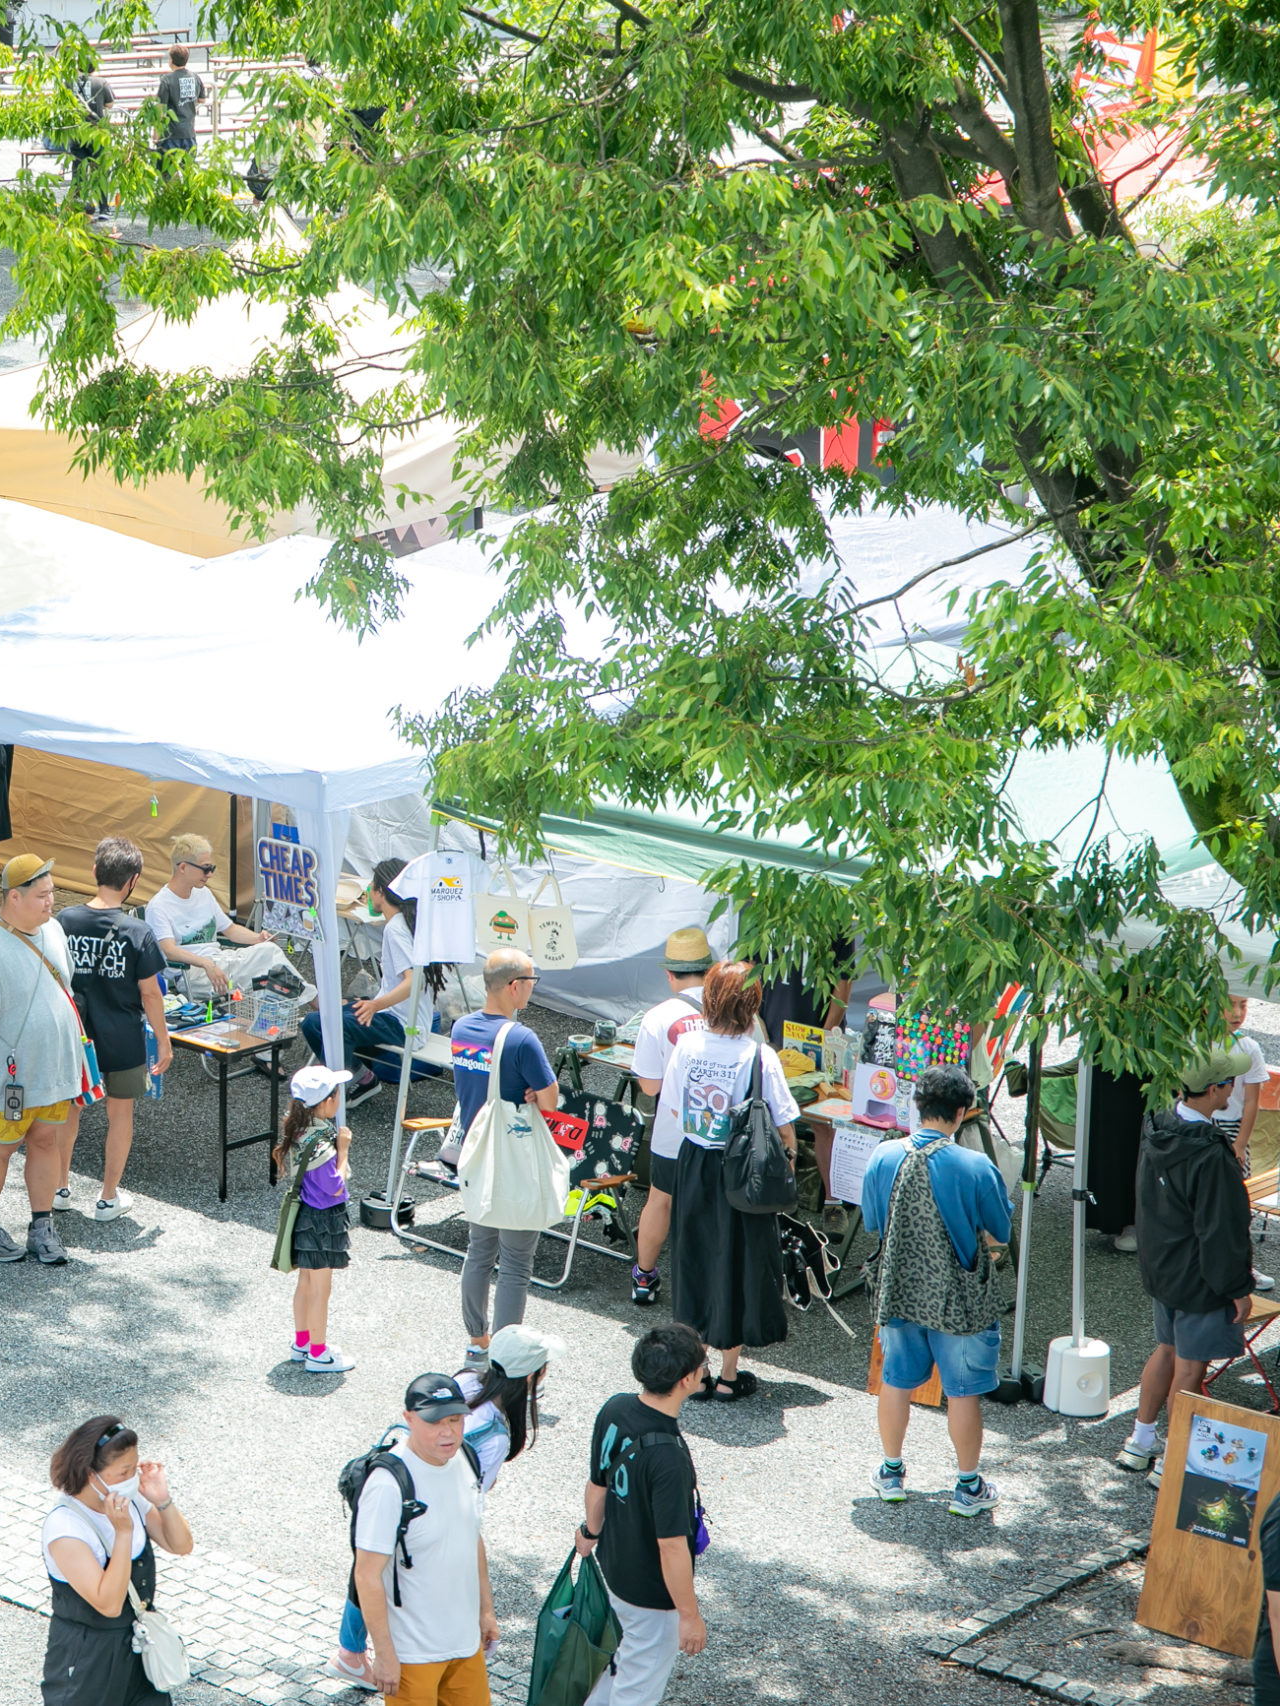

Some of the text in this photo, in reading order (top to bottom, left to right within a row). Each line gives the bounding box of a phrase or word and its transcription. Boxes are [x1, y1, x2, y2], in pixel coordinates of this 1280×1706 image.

[259, 840, 314, 879] CHEAP
[260, 869, 315, 908] TIMES
[107, 969, 125, 979] USA
